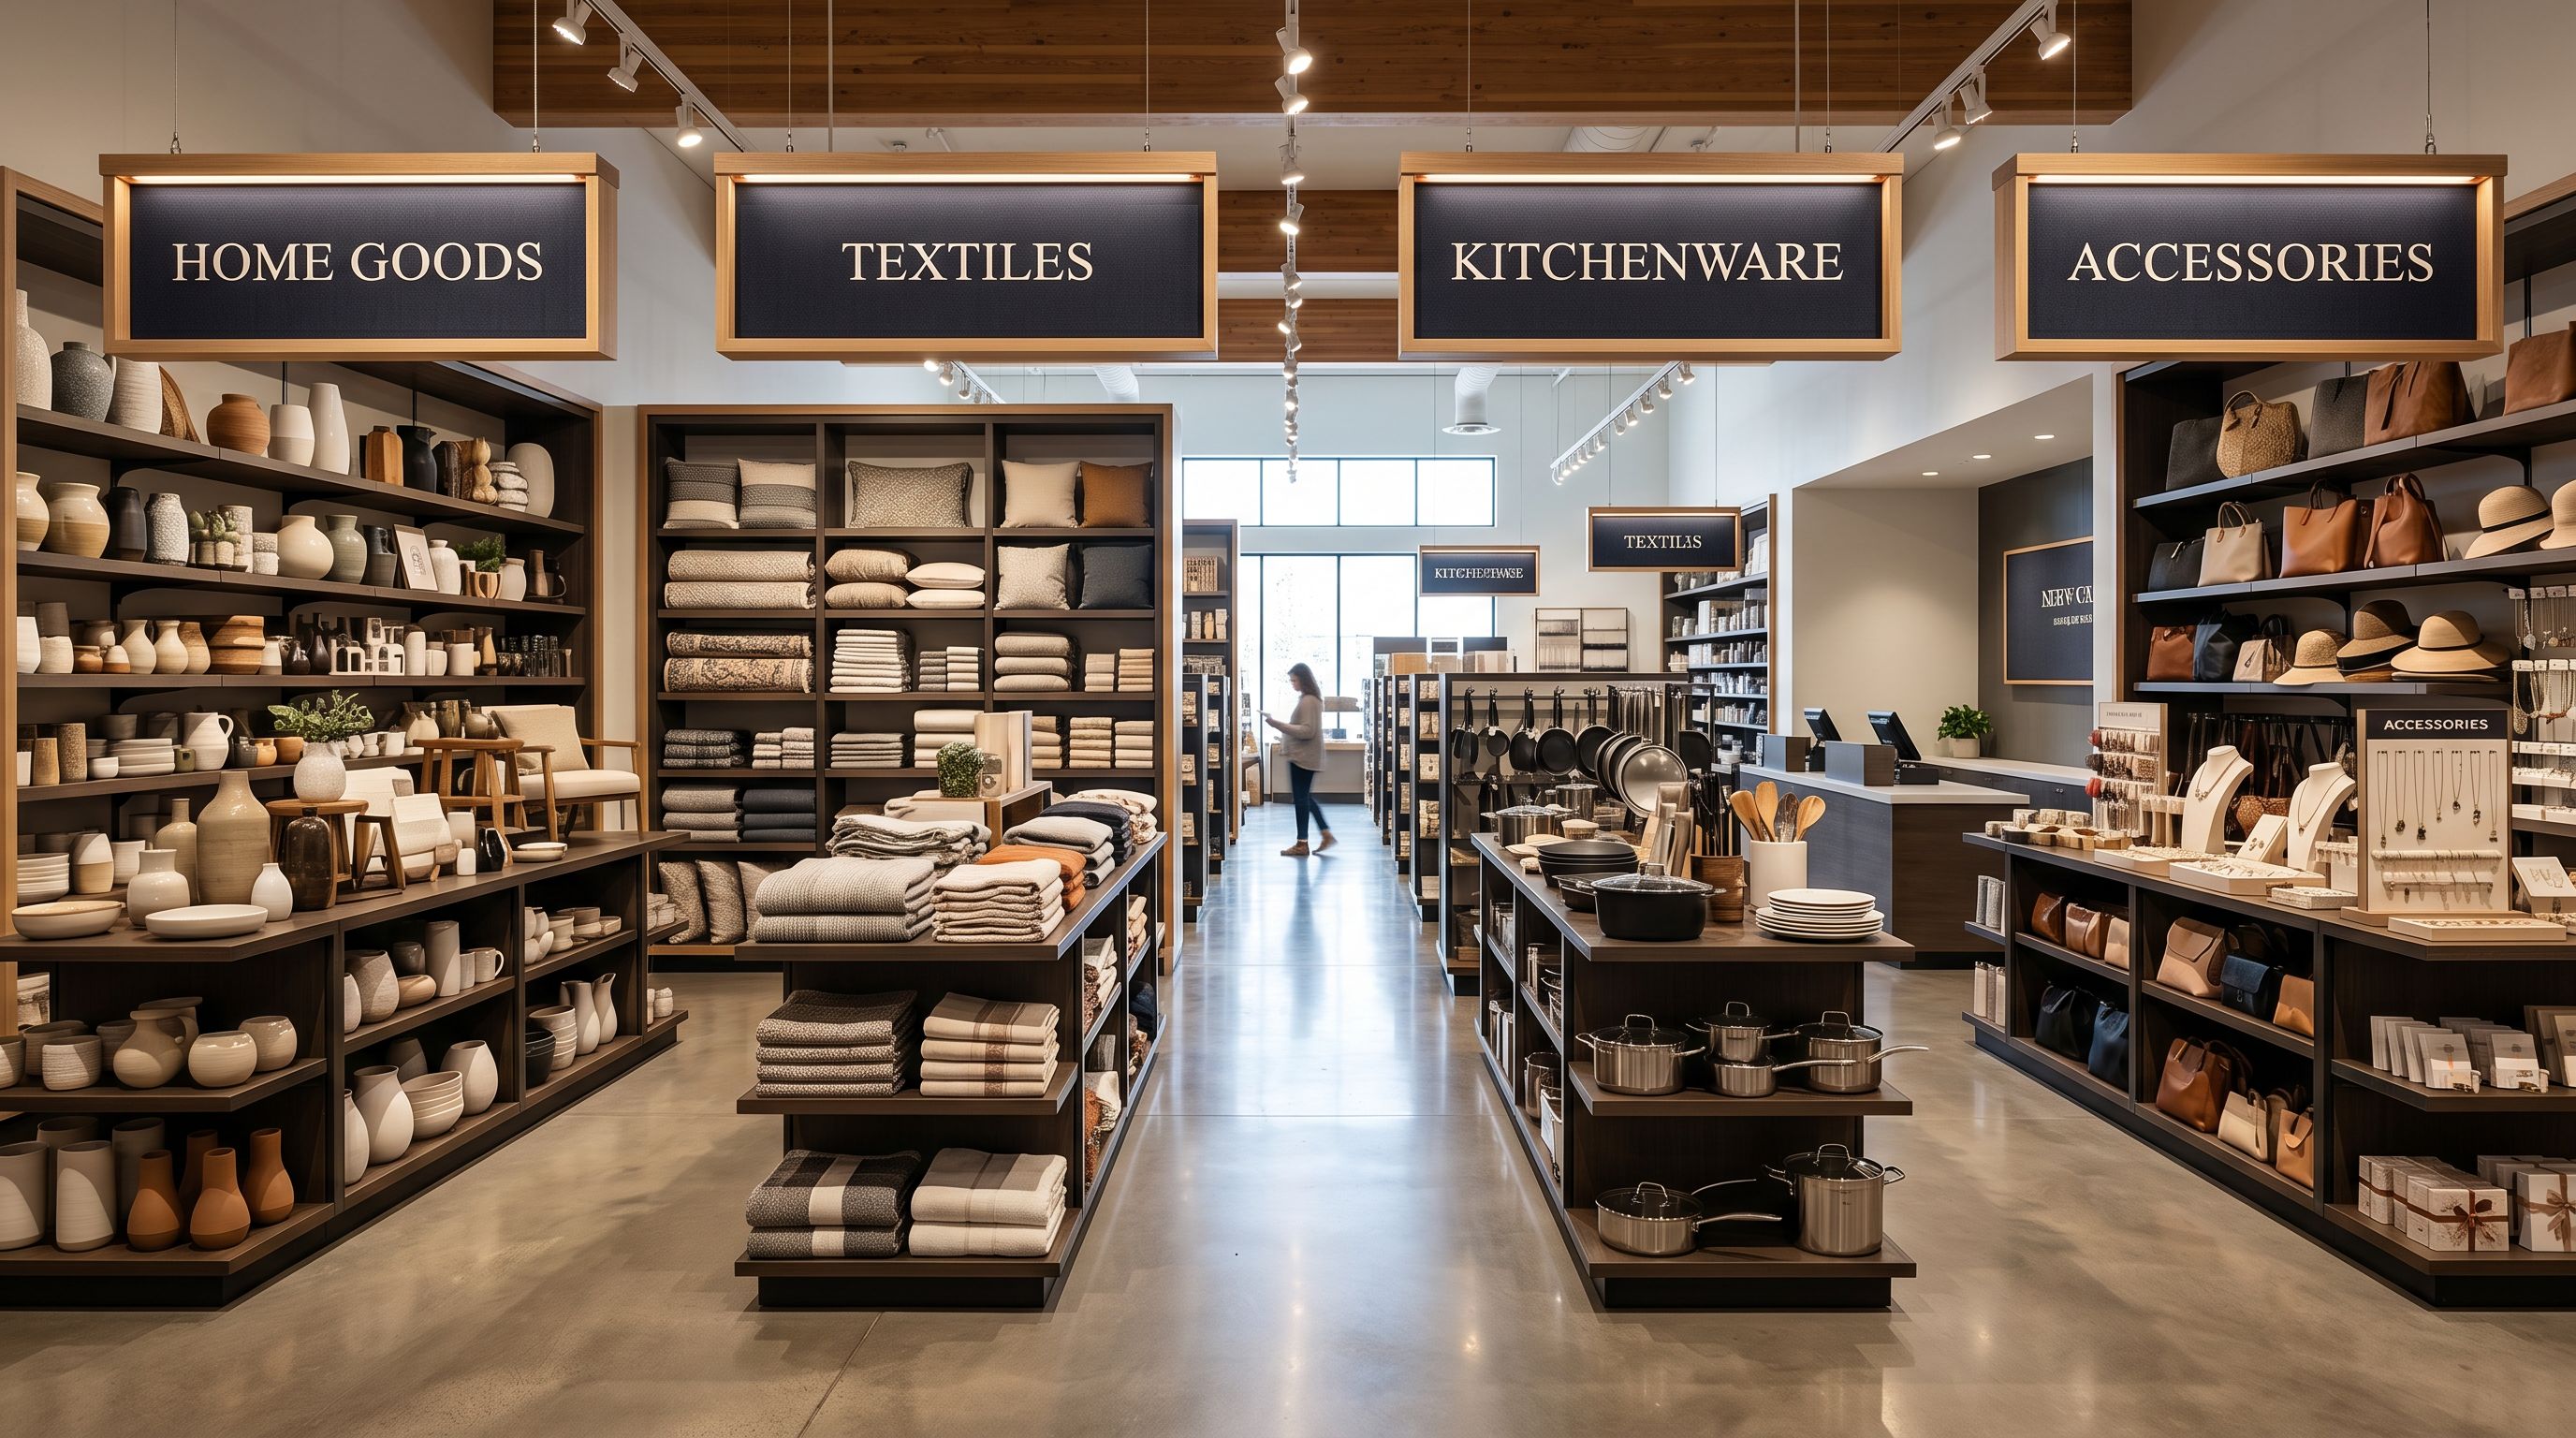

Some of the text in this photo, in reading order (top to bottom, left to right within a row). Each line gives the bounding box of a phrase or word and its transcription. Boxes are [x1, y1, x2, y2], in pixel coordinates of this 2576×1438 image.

[172, 242, 543, 282] HOME GOODS
[842, 242, 1093, 282] TEXTILES
[1451, 242, 1844, 282] KITCHENWARE
[2067, 242, 2434, 282] ACCESSORIES
[2384, 719, 2489, 730] ACCESSORIES
